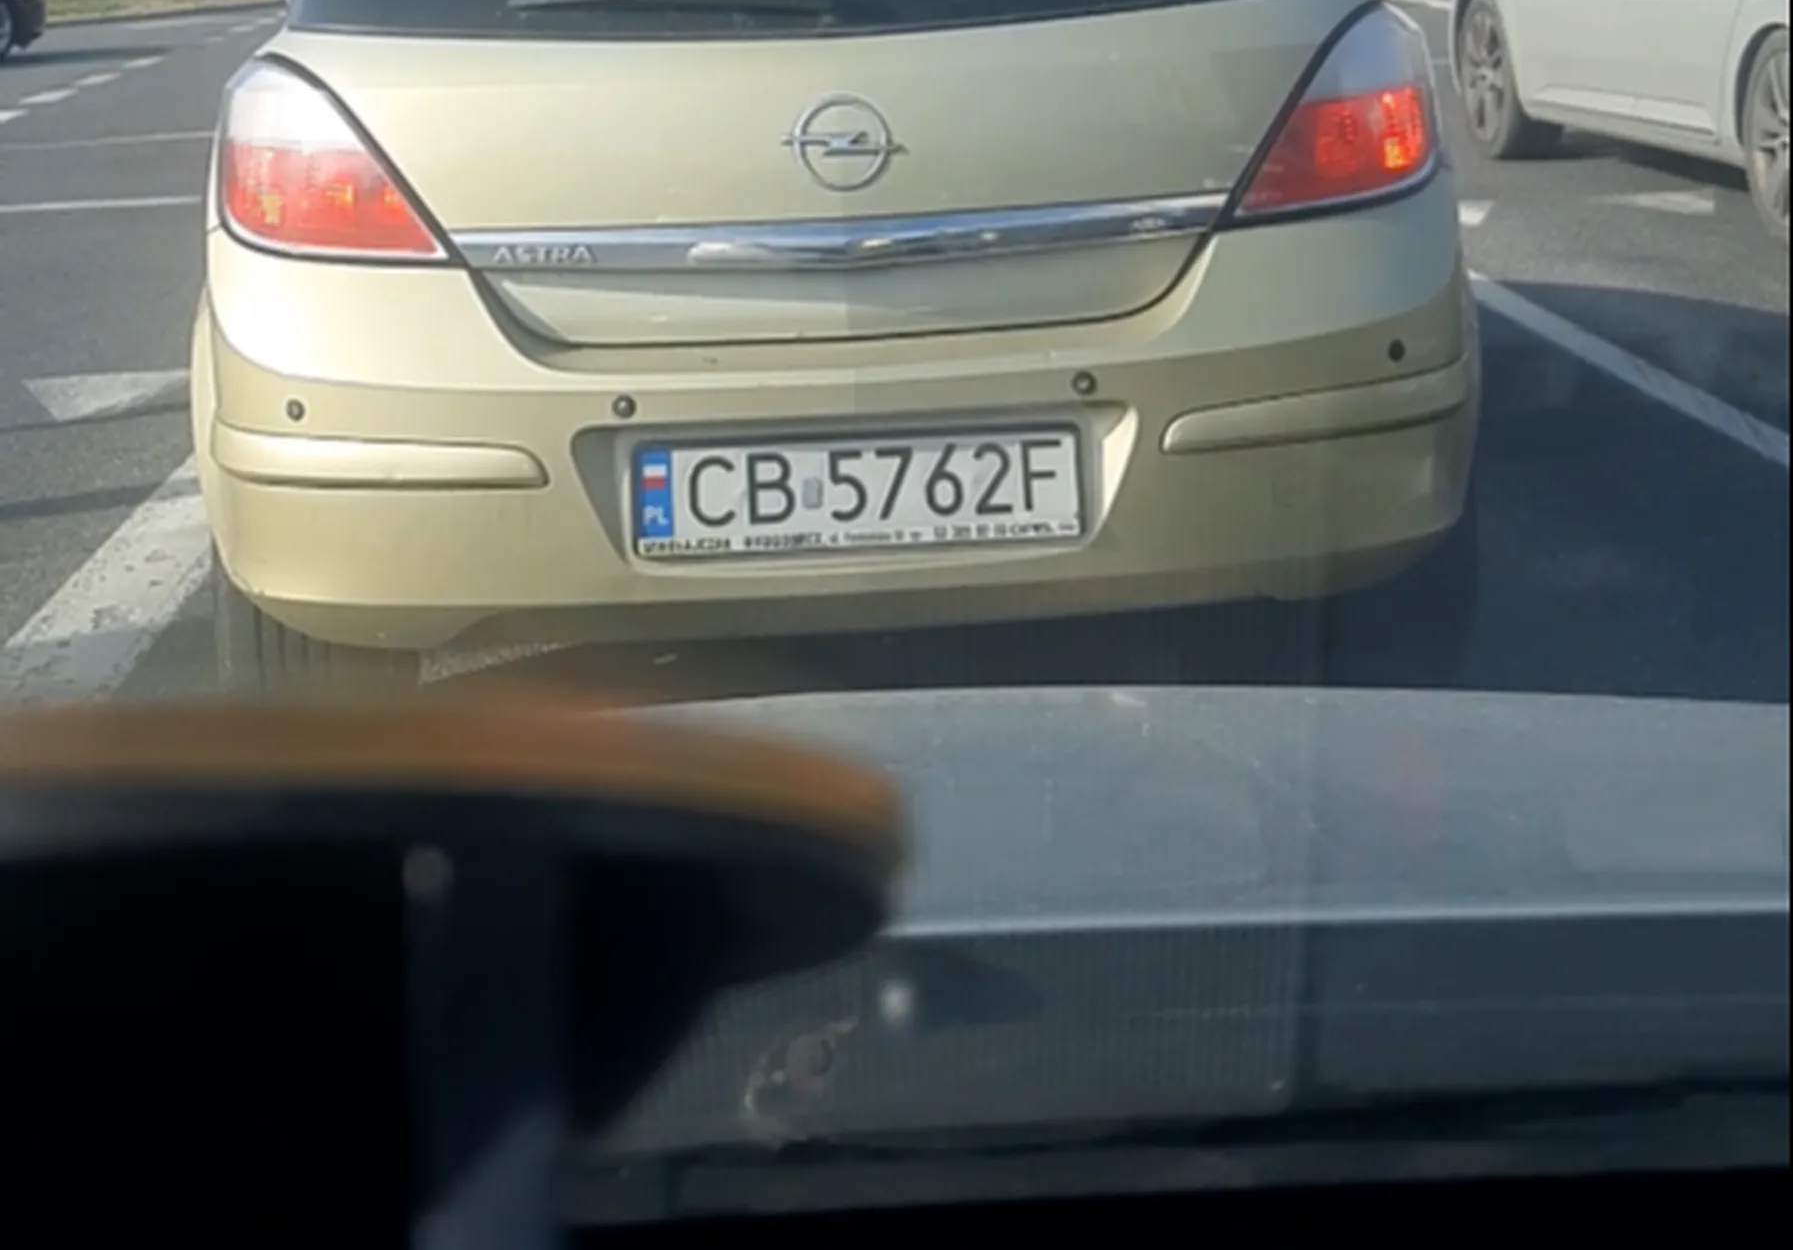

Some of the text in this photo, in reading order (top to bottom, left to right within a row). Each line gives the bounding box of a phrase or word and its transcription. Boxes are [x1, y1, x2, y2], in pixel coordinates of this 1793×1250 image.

[493, 245, 598, 263] ASTRA
[688, 439, 1063, 527] CB 5762F
